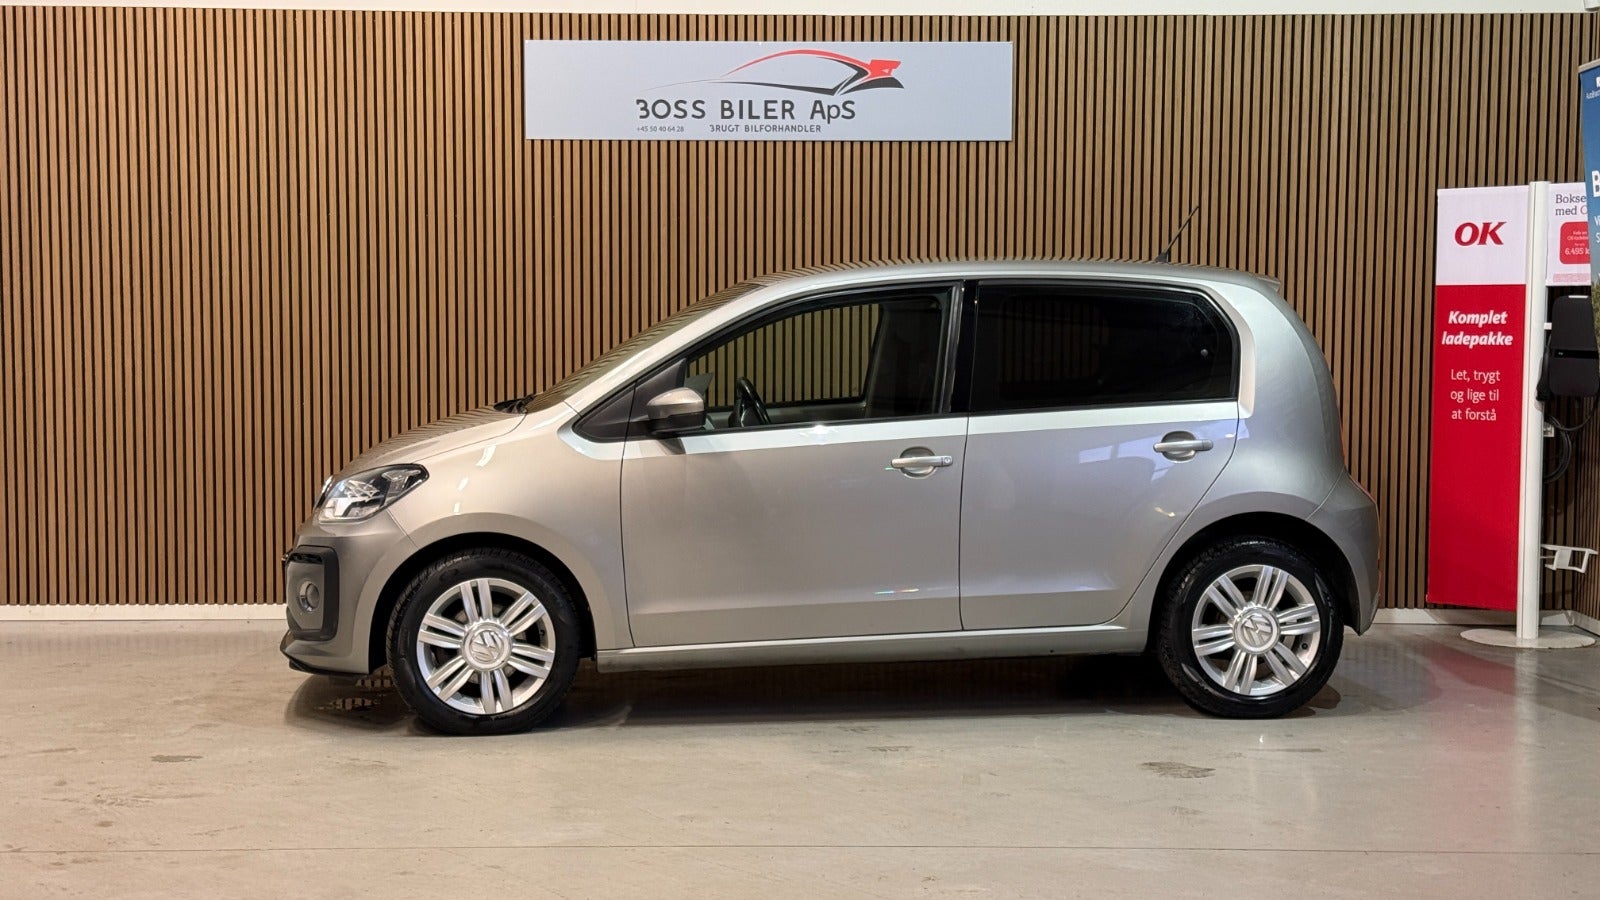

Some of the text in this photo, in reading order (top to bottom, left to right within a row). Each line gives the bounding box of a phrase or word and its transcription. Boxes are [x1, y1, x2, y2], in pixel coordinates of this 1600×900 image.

[720, 99, 795, 119] BILER
[809, 99, 856, 124] ApS
[744, 124, 821, 132] BILFORHANDLER
[1555, 206, 1577, 216] med
[1454, 221, 1507, 246] OK
[1448, 310, 1508, 328] Komplet
[1441, 331, 1513, 349] ladepakke
[1451, 369, 1501, 385] Let, trygt
[1450, 388, 1499, 404] og lige til
[1451, 408, 1497, 421] at forstå
